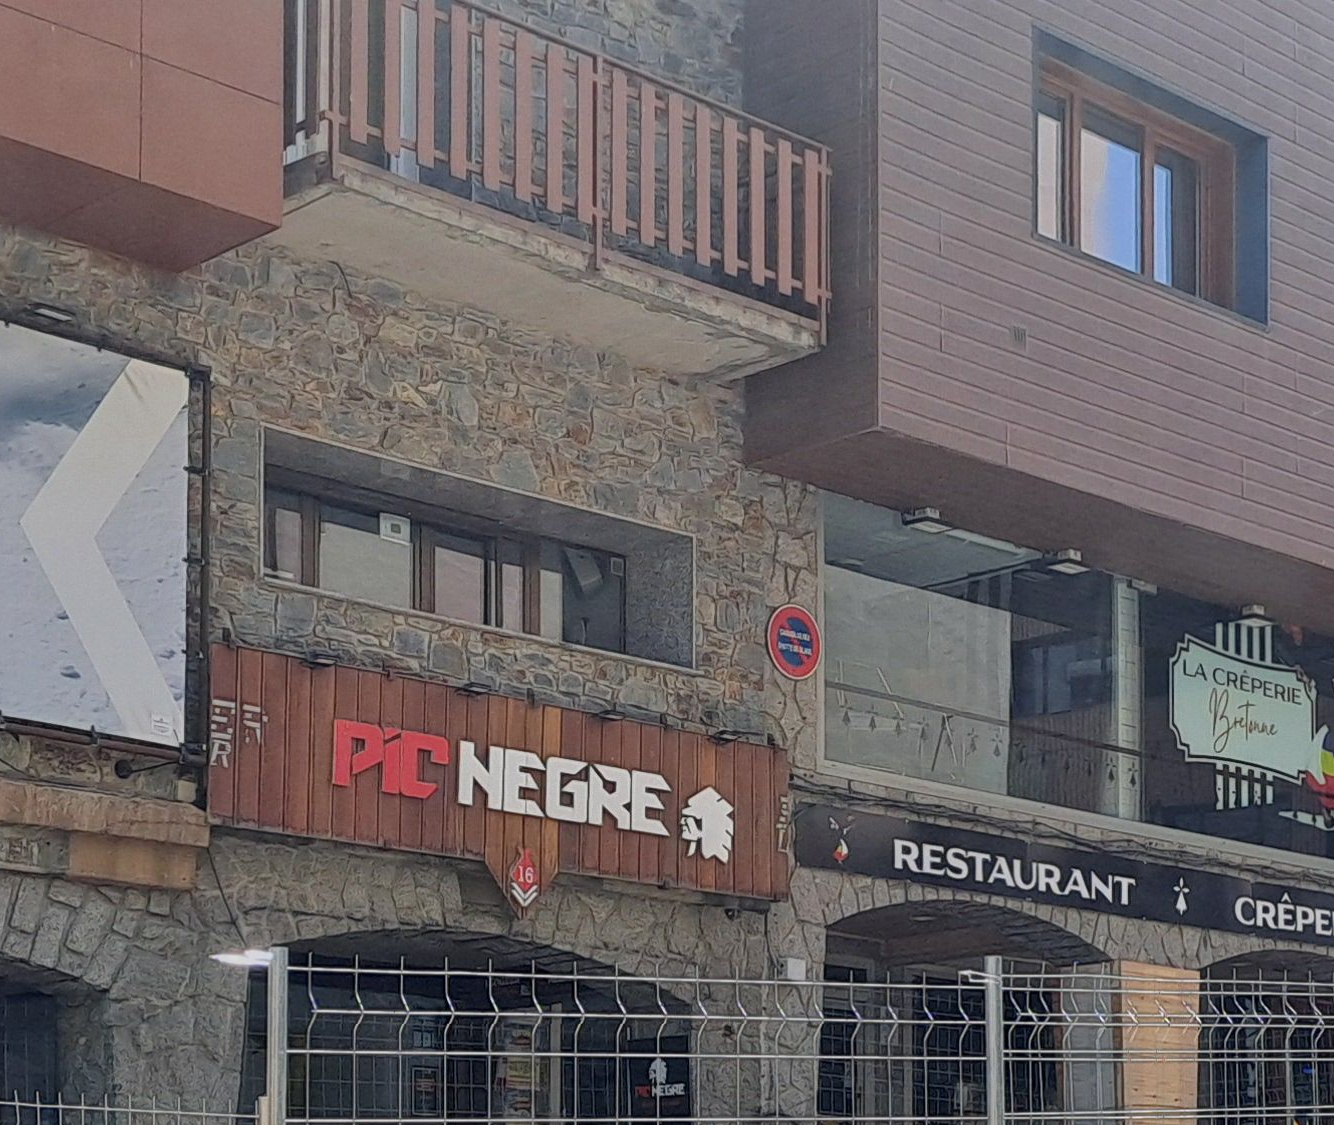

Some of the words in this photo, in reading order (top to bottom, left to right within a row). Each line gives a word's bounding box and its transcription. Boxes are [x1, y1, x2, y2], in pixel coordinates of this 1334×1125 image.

[1182, 659, 1207, 681] LA
[1212, 667, 1303, 705] CRÊPERIE
[1208, 687, 1278, 754] Bretonne
[457, 739, 673, 838] NEGRE
[518, 865, 535, 884] 16
[892, 838, 1136, 907] RESTAURANT
